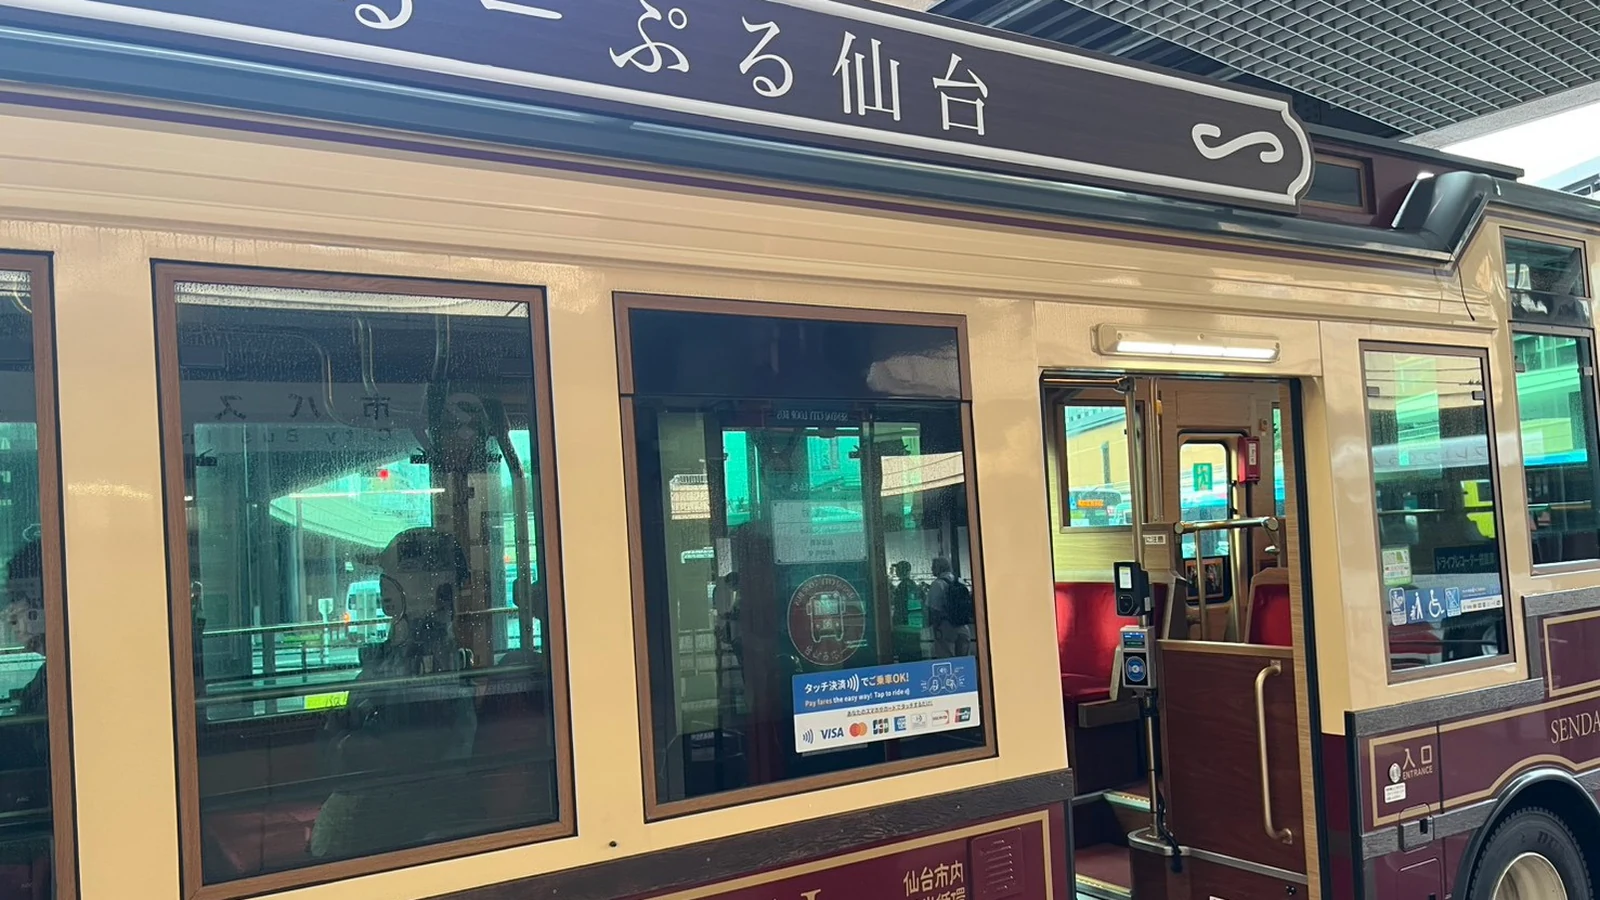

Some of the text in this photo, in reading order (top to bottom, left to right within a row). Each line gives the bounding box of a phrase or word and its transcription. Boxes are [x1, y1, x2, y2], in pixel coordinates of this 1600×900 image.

[804, 680, 847, 694] タッチ決済
[804, 699, 817, 708] Pay
[817, 697, 833, 706] fares
[833, 696, 844, 704] the
[844, 695, 857, 704] easy
[859, 693, 873, 702] way!
[874, 691, 885, 699] Tap
[892, 688, 904, 697] ride
[820, 727, 844, 740] VISA
[1402, 744, 1433, 771] 入口
[1402, 765, 1433, 780] ENTRANCE
[903, 860, 964, 897] 仙台市内
